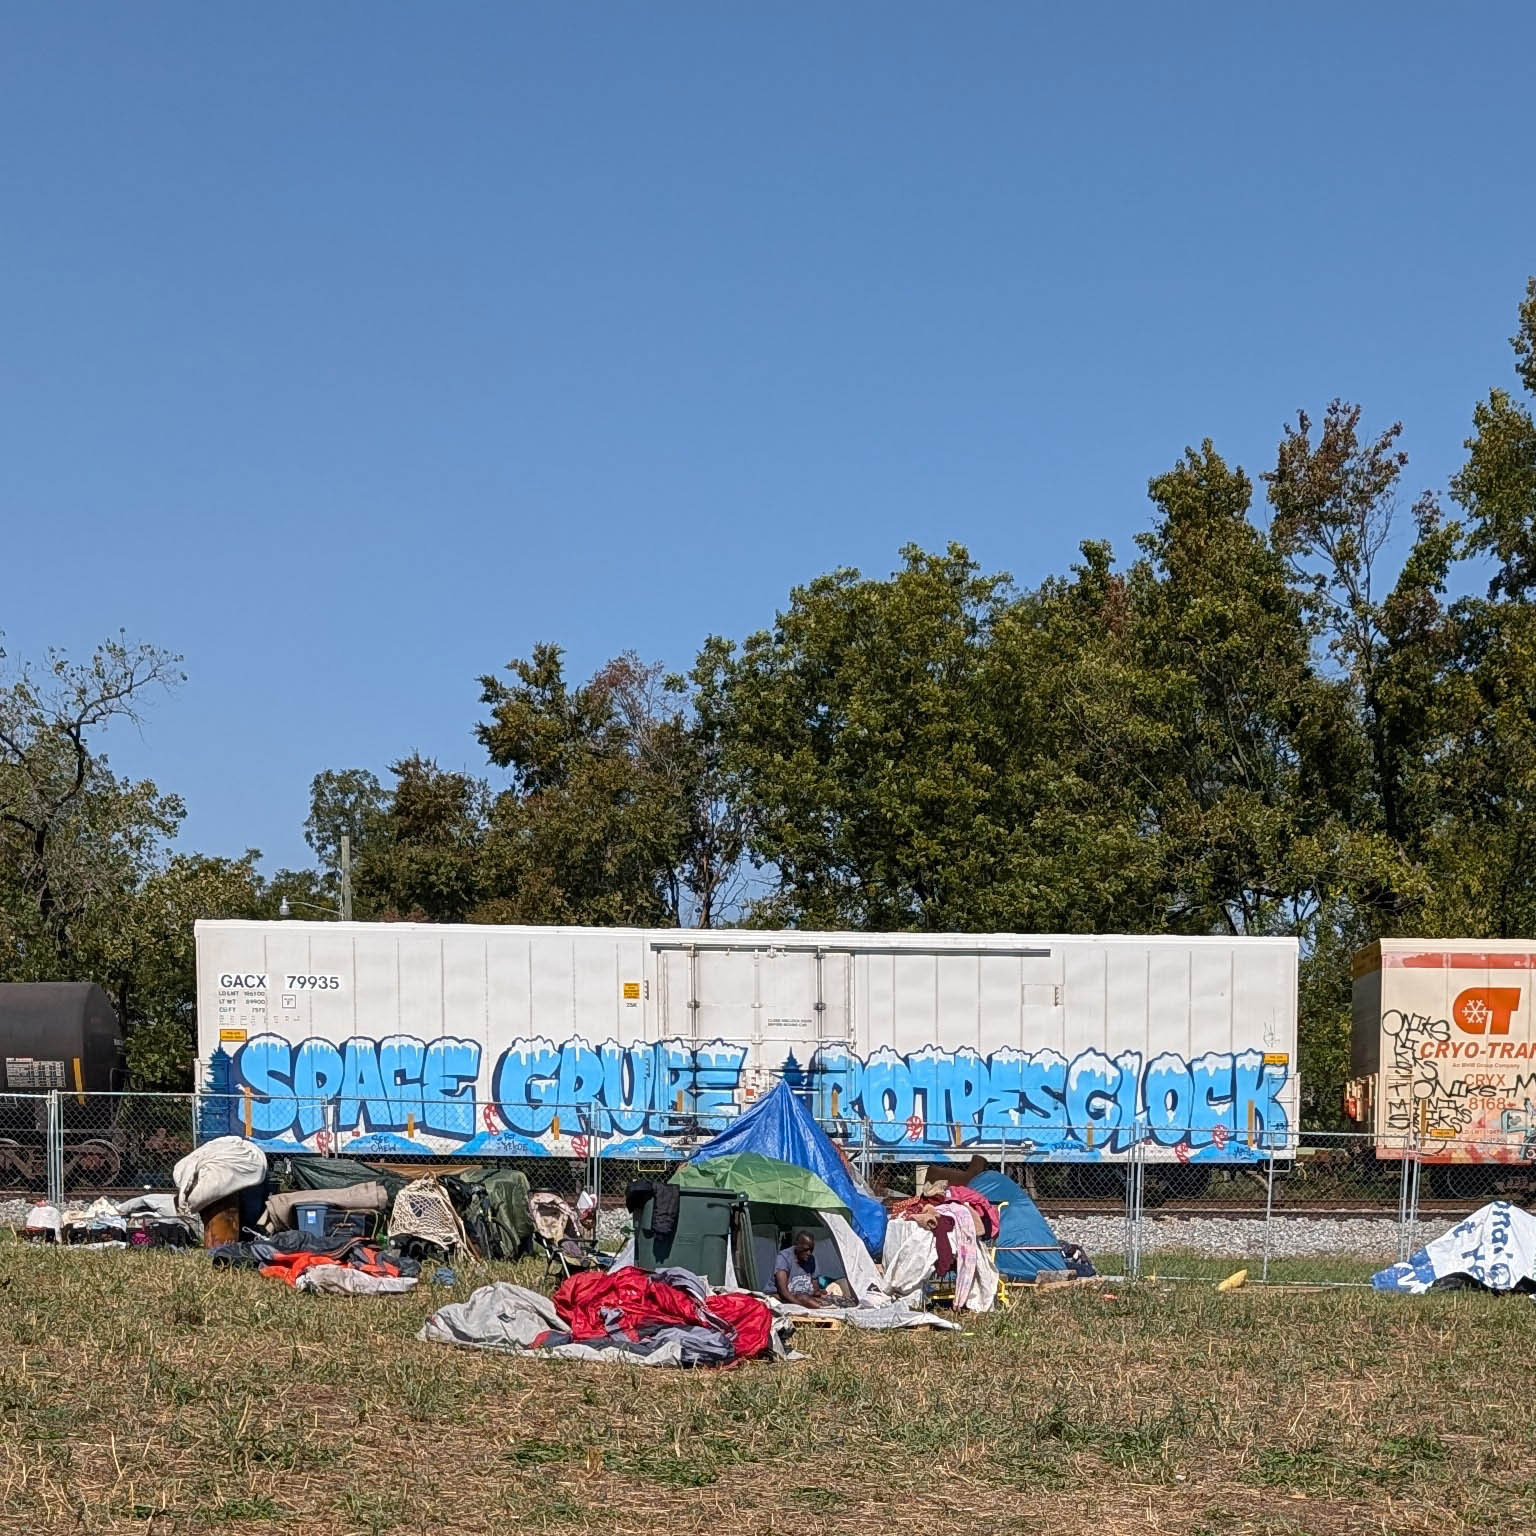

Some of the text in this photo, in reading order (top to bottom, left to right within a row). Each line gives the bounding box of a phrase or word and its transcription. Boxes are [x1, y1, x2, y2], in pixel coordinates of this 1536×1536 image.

[220, 974, 340, 990] GACX 79935
[234, 1032, 482, 1140] SPACE
[1464, 1073, 1506, 1087] CRYX
[1468, 1097, 1506, 1111] 8168
